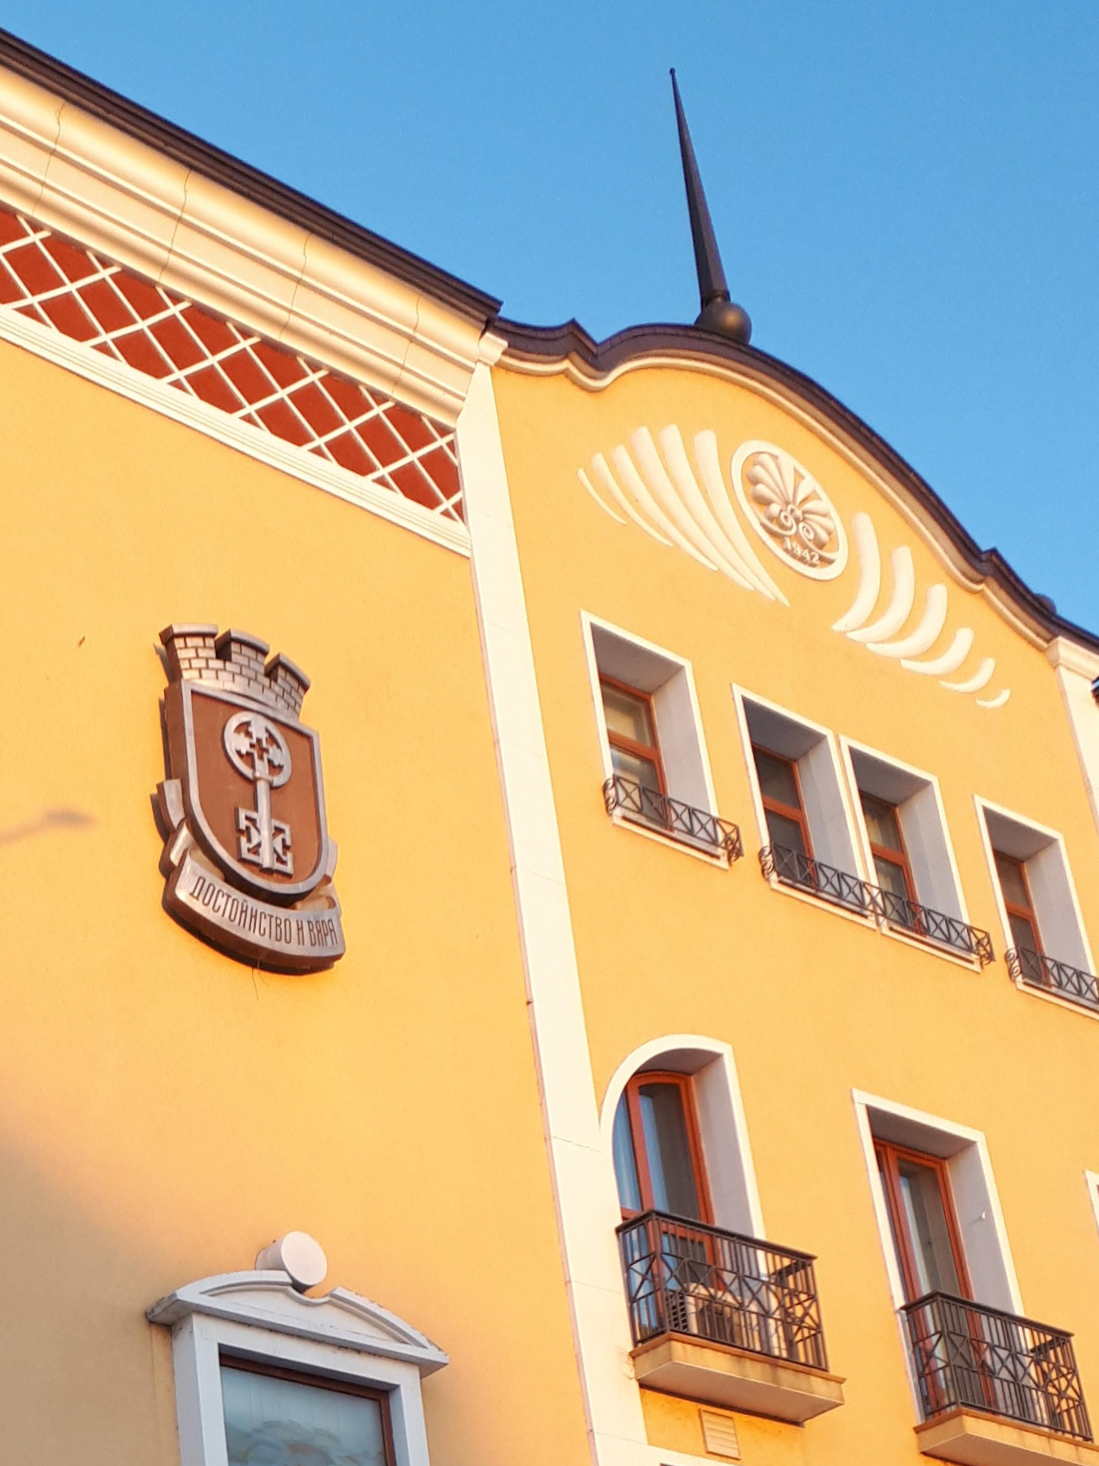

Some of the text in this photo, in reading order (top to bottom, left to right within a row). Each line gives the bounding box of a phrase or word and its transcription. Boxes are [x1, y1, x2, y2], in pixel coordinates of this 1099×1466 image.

[783, 537, 820, 565] 1942
[189, 876, 292, 944] ДОСТОЙНСТВО
[307, 918, 339, 947] ВЯРА
